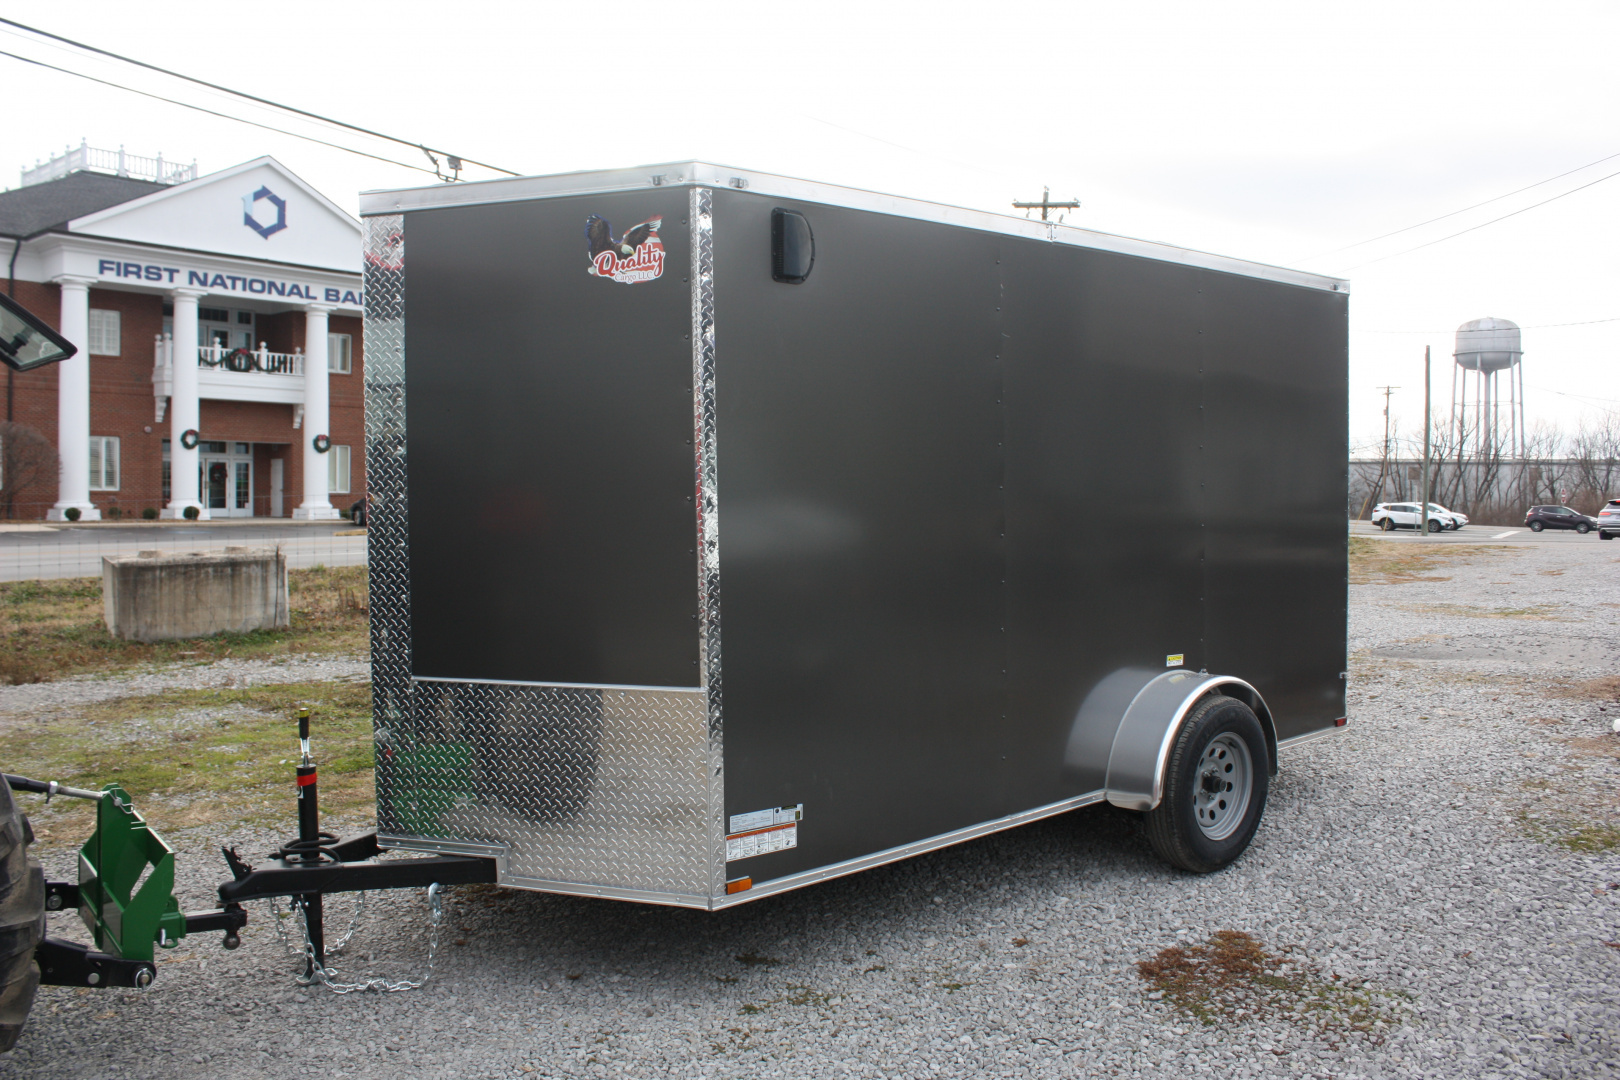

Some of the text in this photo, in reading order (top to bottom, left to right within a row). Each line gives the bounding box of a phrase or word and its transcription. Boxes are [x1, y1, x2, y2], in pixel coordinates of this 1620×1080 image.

[594, 244, 664, 277] Quality
[98, 259, 180, 283] FIRST
[187, 270, 317, 300] NATIONAL
[614, 272, 636, 283] Cargo
